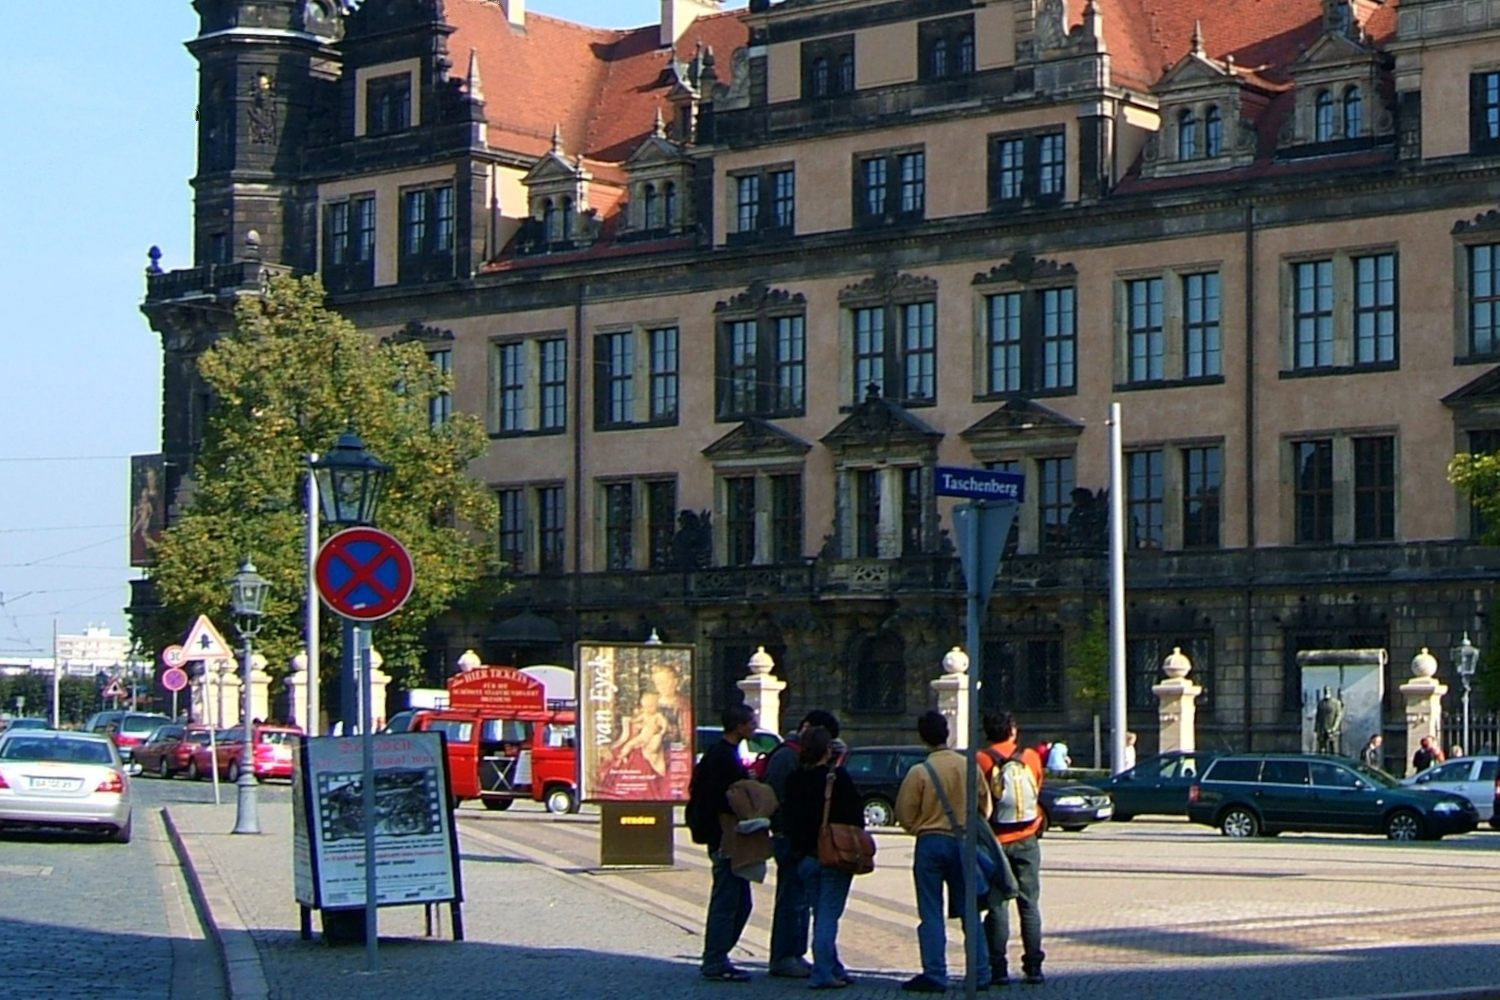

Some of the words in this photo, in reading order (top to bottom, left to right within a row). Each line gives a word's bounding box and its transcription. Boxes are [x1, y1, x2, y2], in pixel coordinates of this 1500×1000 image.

[942, 473, 1018, 497] Taschenberg
[588, 652, 618, 702] Eyck
[595, 710, 612, 745] van
